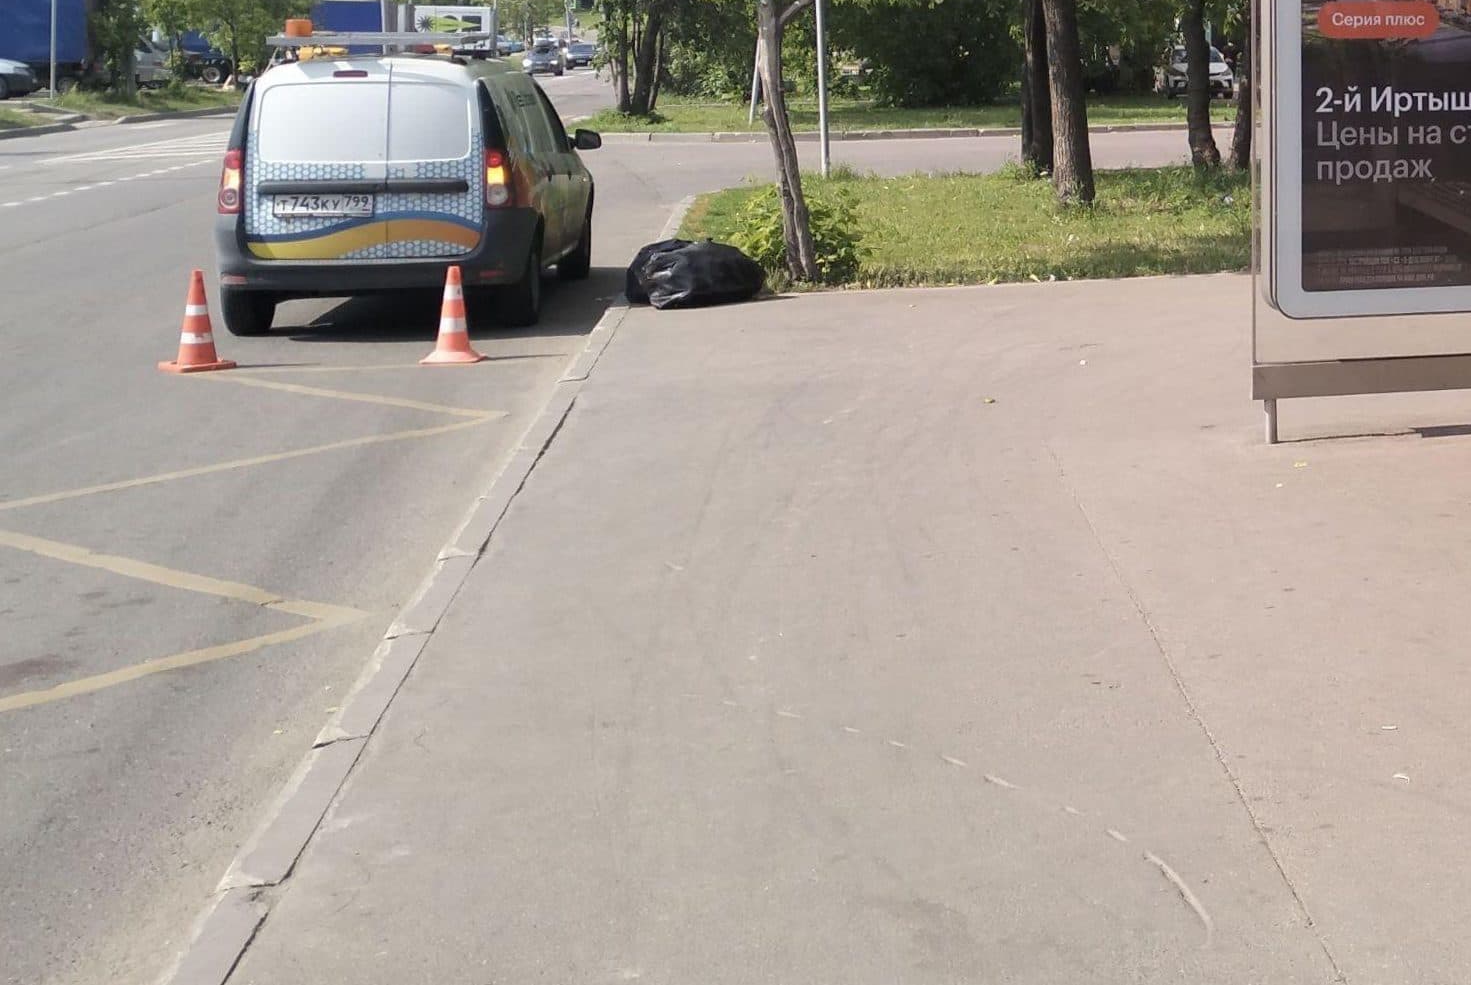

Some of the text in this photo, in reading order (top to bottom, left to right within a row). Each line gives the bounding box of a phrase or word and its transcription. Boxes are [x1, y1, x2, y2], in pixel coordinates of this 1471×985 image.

[1331, 12, 1425, 29] Серия плюс
[1315, 85, 1362, 114] 2-й
[1316, 120, 1399, 150] Цены
[1407, 124, 1442, 145] на
[1316, 158, 1434, 186] продаж
[343, 196, 370, 208] 799
